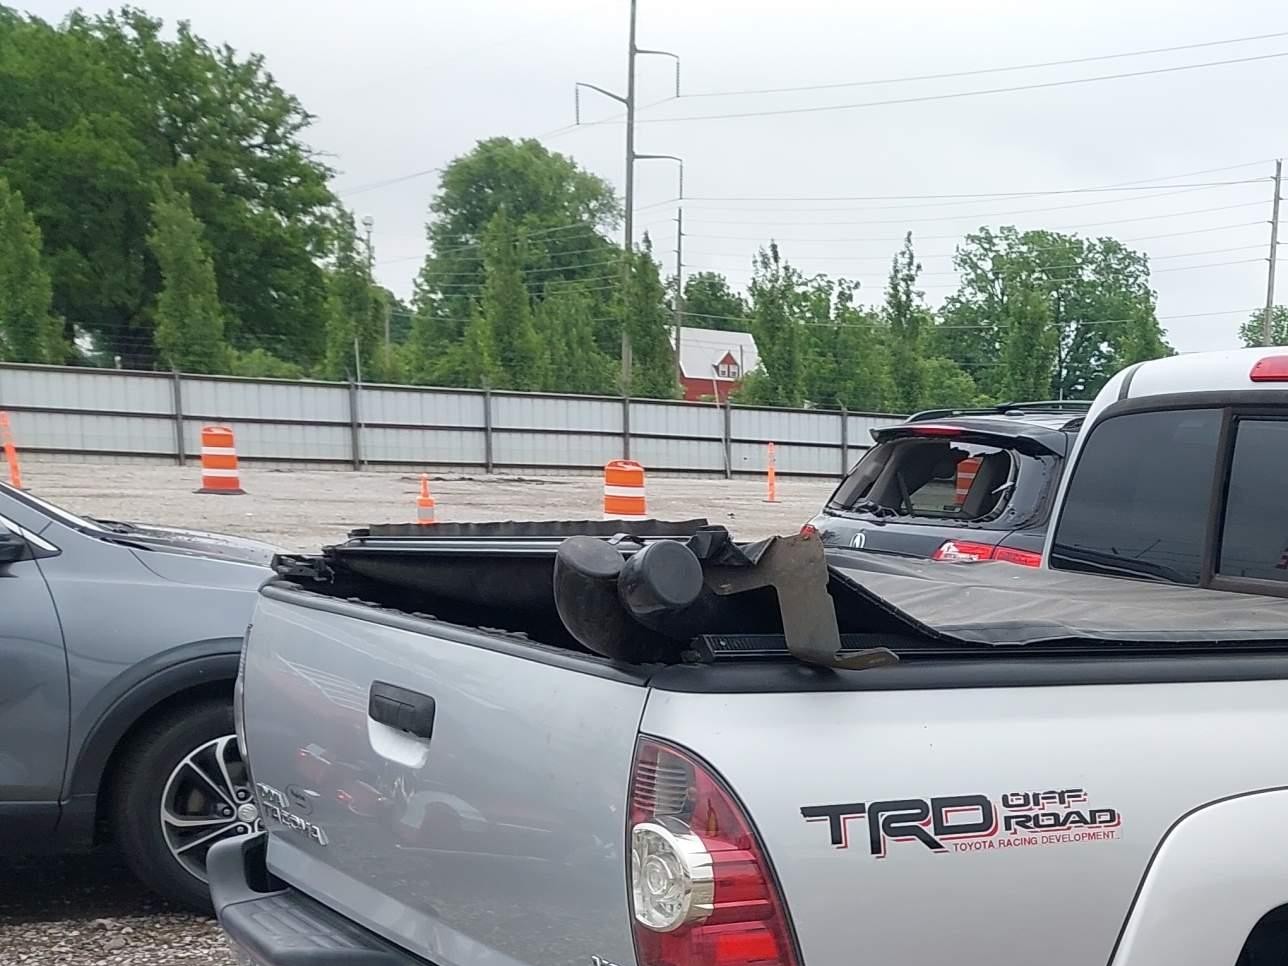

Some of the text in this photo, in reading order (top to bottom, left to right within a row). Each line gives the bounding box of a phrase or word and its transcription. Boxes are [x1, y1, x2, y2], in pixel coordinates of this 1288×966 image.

[1001, 788, 1088, 811] OFF
[800, 794, 1000, 858] TRD
[1003, 808, 1121, 835] ROAD
[953, 831, 1116, 852] TOYOTA RACING DEVELOPMENT
